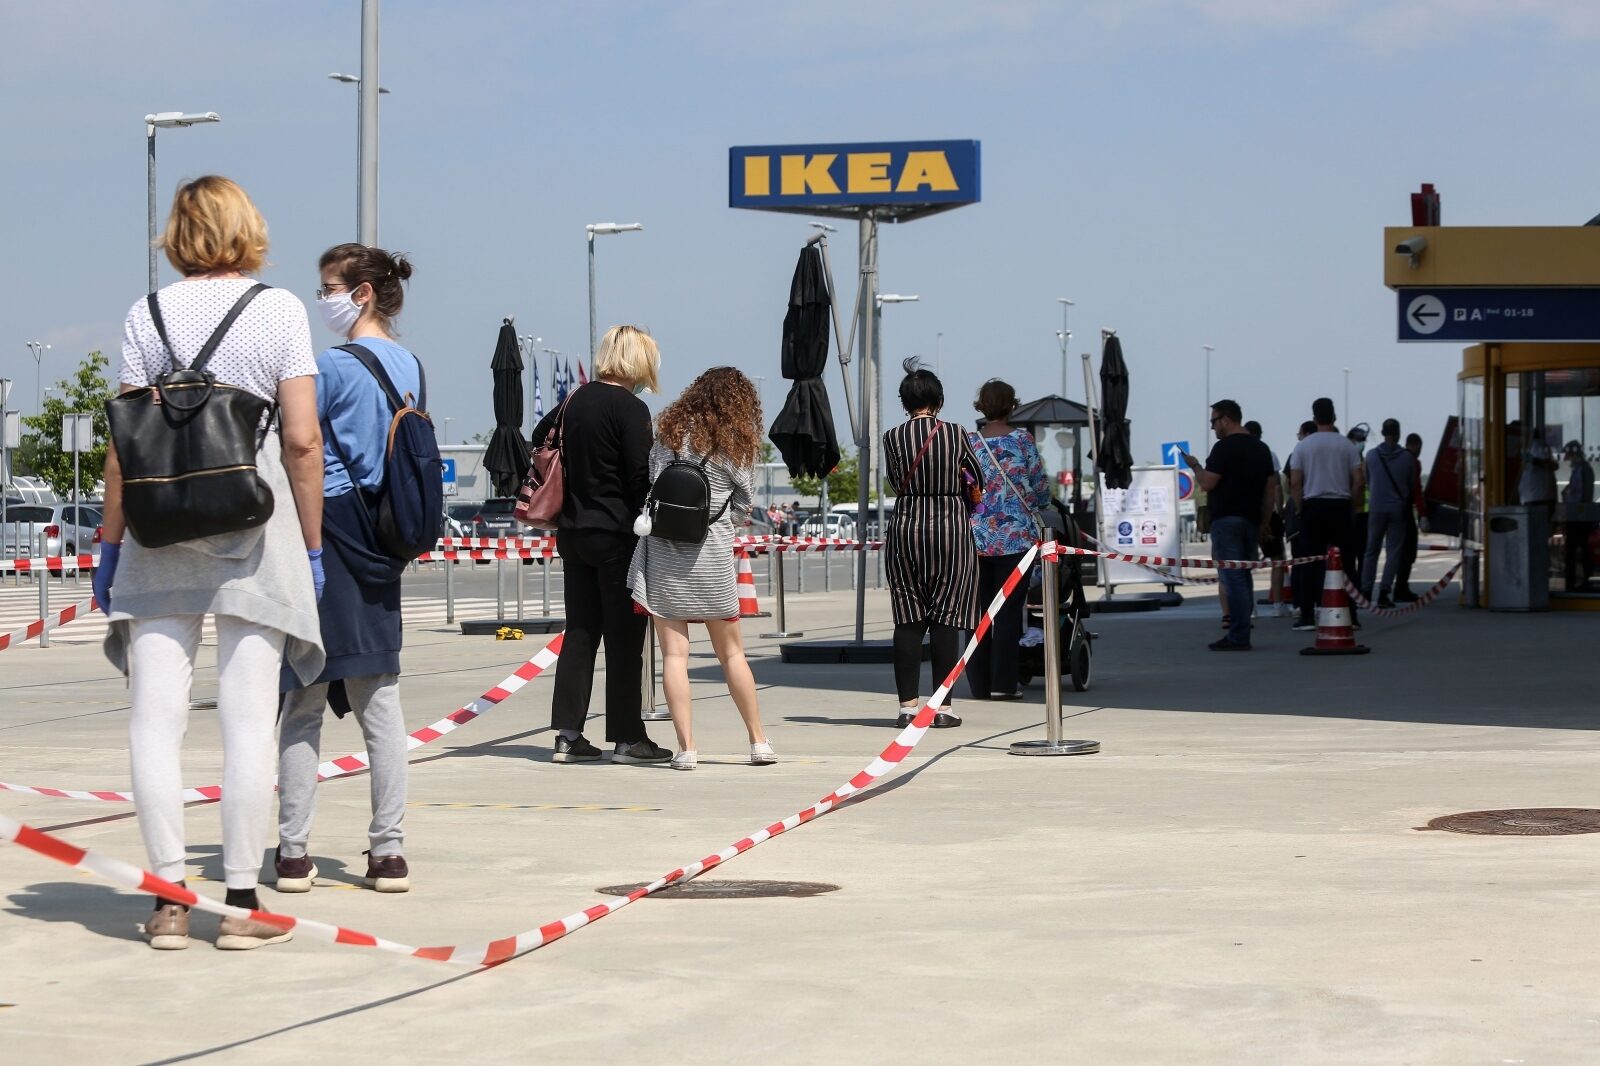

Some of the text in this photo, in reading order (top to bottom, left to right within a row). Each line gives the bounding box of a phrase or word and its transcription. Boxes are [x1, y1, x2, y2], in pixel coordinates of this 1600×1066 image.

[744, 150, 960, 196] IKEA
[1455, 309, 1465, 320] P
[1470, 308, 1482, 321] A
